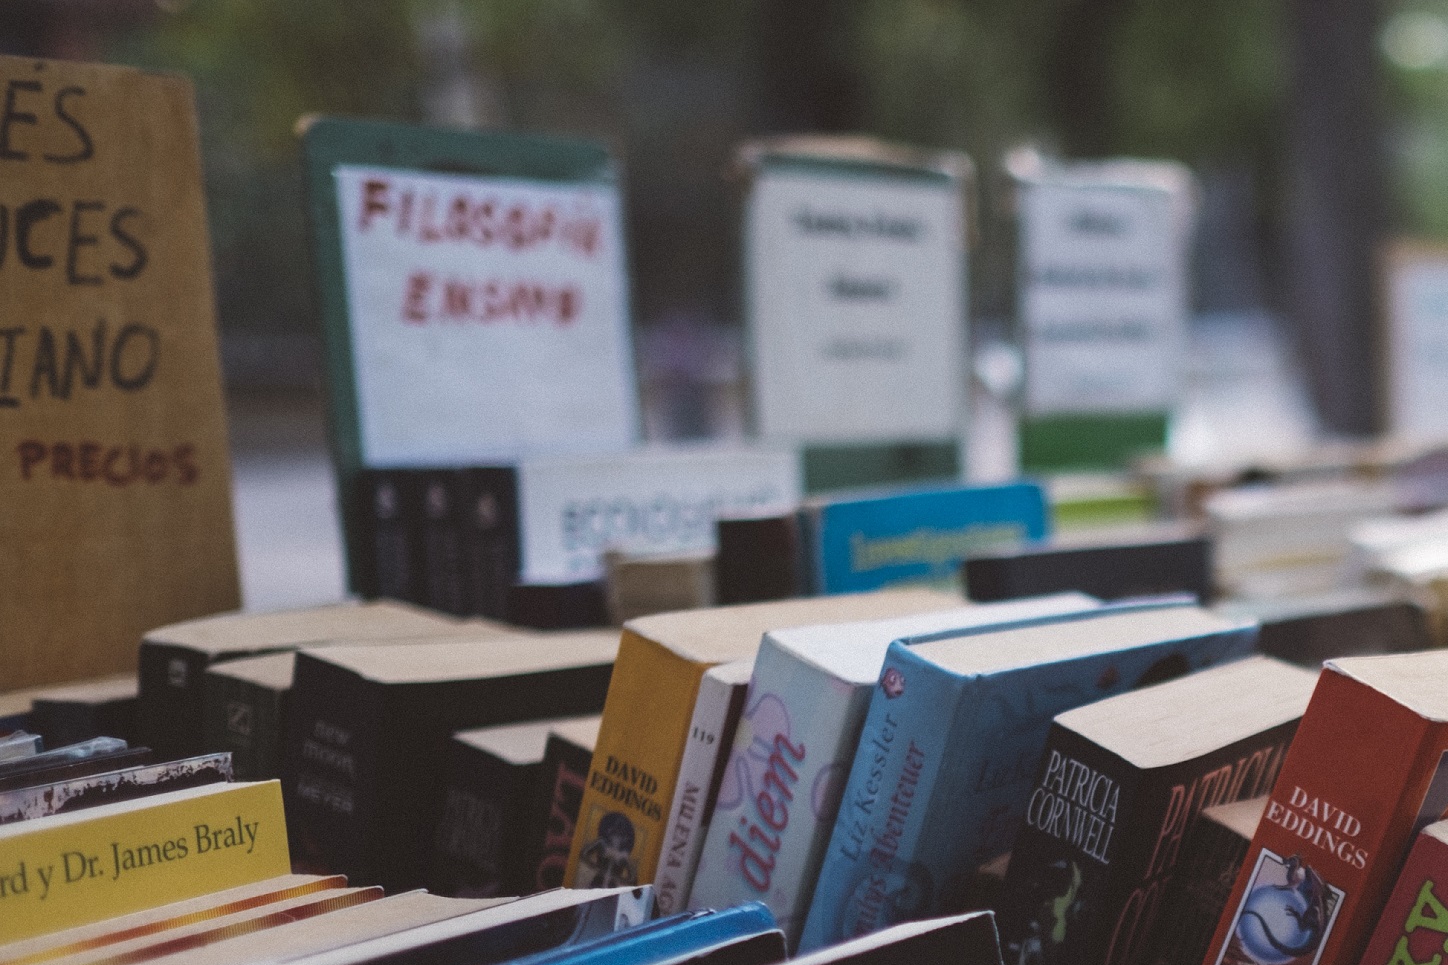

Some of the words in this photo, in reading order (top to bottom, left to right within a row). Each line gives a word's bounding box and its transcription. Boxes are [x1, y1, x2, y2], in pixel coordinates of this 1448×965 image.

[0, 197, 149, 287] CES
[17, 438, 199, 488] PRECIOS
[692, 726, 715, 746] 119
[853, 712, 899, 817] Kessler
[589, 771, 663, 823] EDDINGS
[605, 755, 659, 796] DAVID
[1043, 750, 1120, 824] PATRICIA
[1289, 785, 1363, 838] DAVID
[666, 782, 700, 869] MILENA
[728, 732, 806, 893] diem
[840, 825, 867, 864] Liz
[1026, 787, 1116, 865] CORNWELL
[1265, 801, 1369, 871] EDDINGS
[37, 865, 55, 901] y
[62, 850, 104, 885] Dr.
[111, 836, 189, 881] James
[194, 816, 260, 854] Braly
